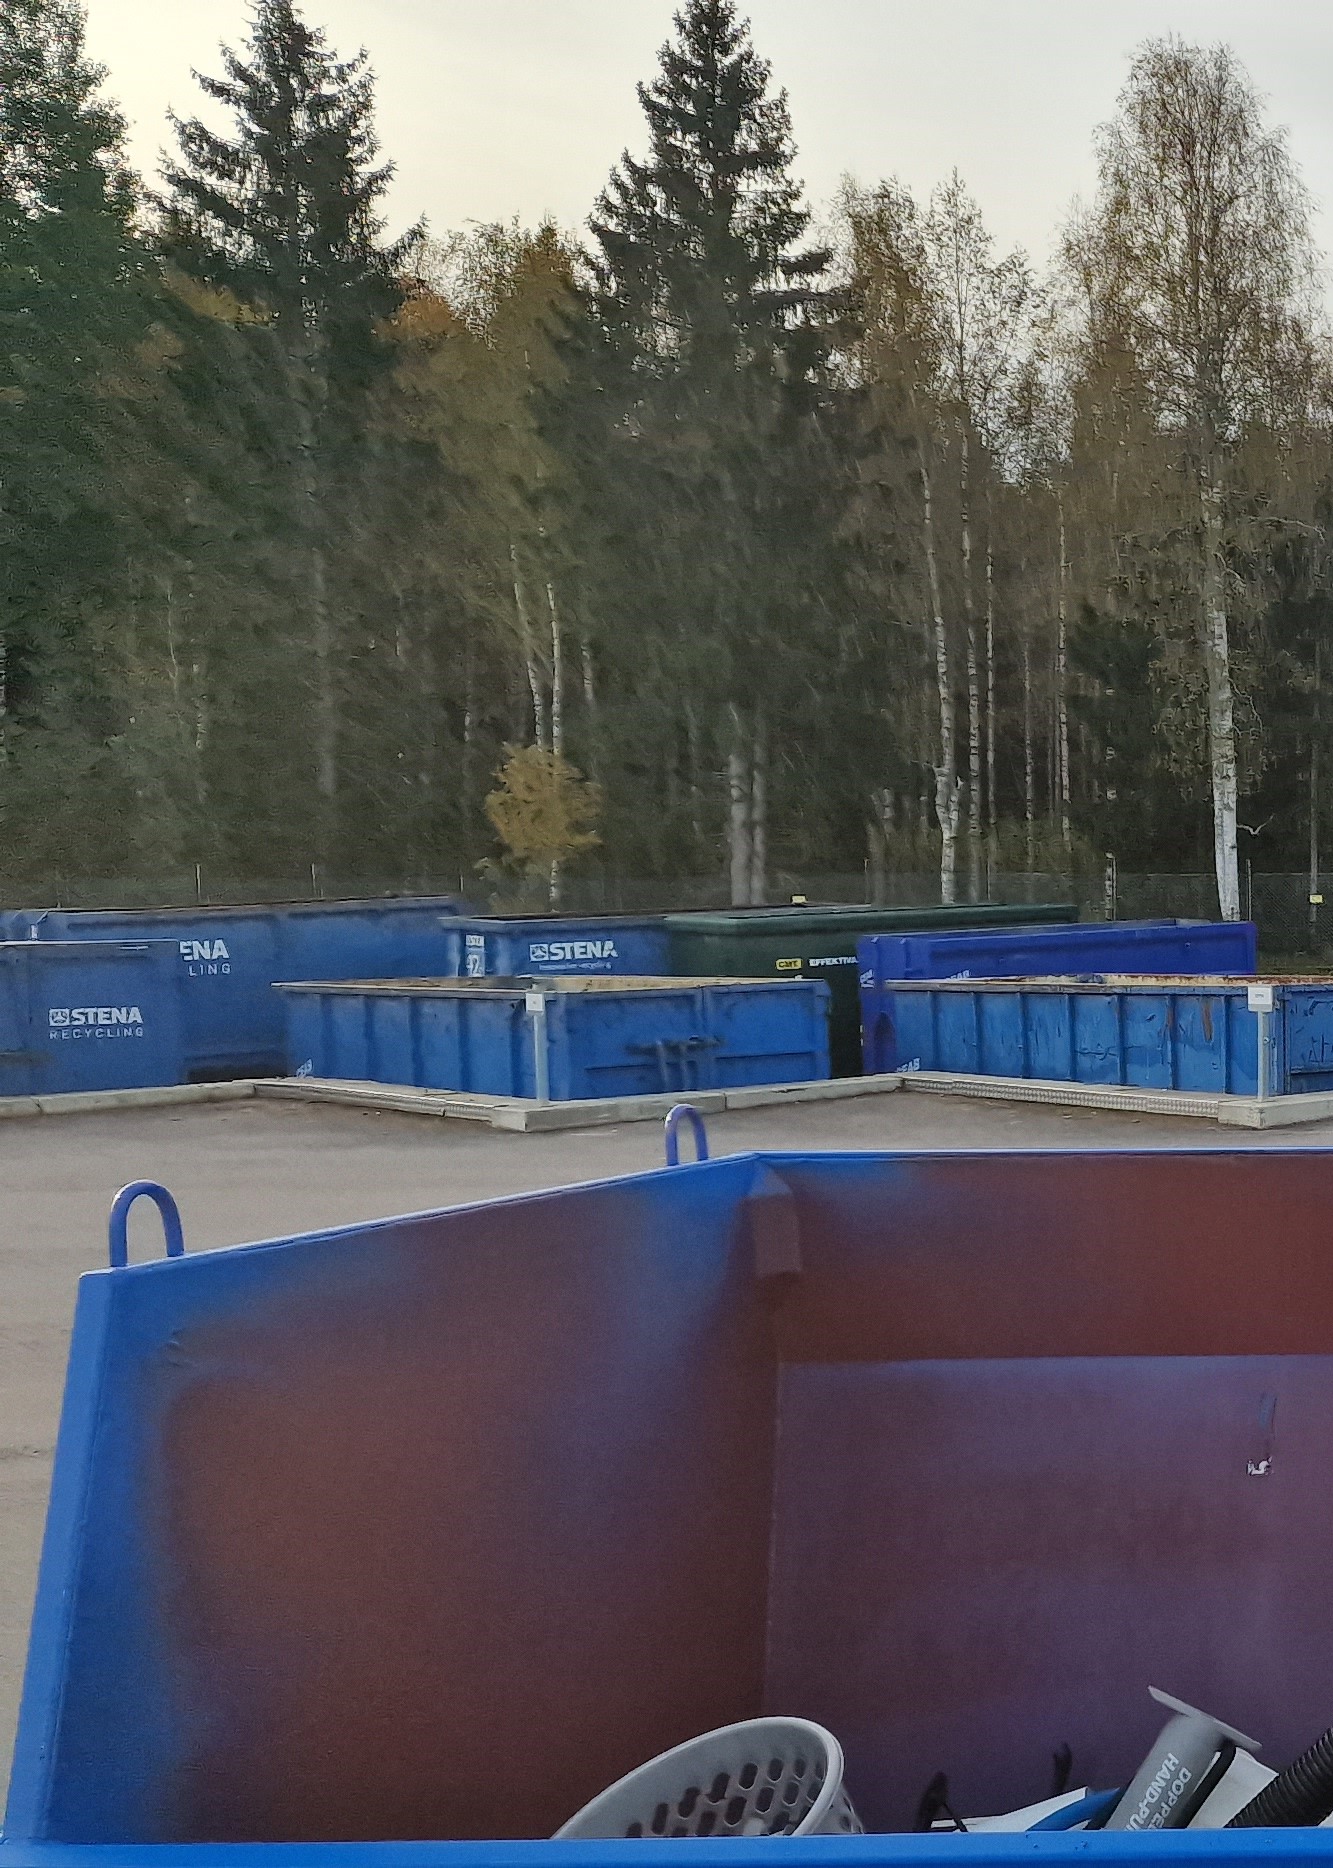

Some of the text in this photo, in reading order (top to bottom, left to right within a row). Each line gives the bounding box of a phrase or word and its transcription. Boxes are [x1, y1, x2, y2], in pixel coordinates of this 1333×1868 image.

[180, 939, 230, 960] ENA
[549, 941, 618, 960] STENA
[71, 1007, 144, 1026] STENA
[49, 1027, 144, 1040] RECYCLING
